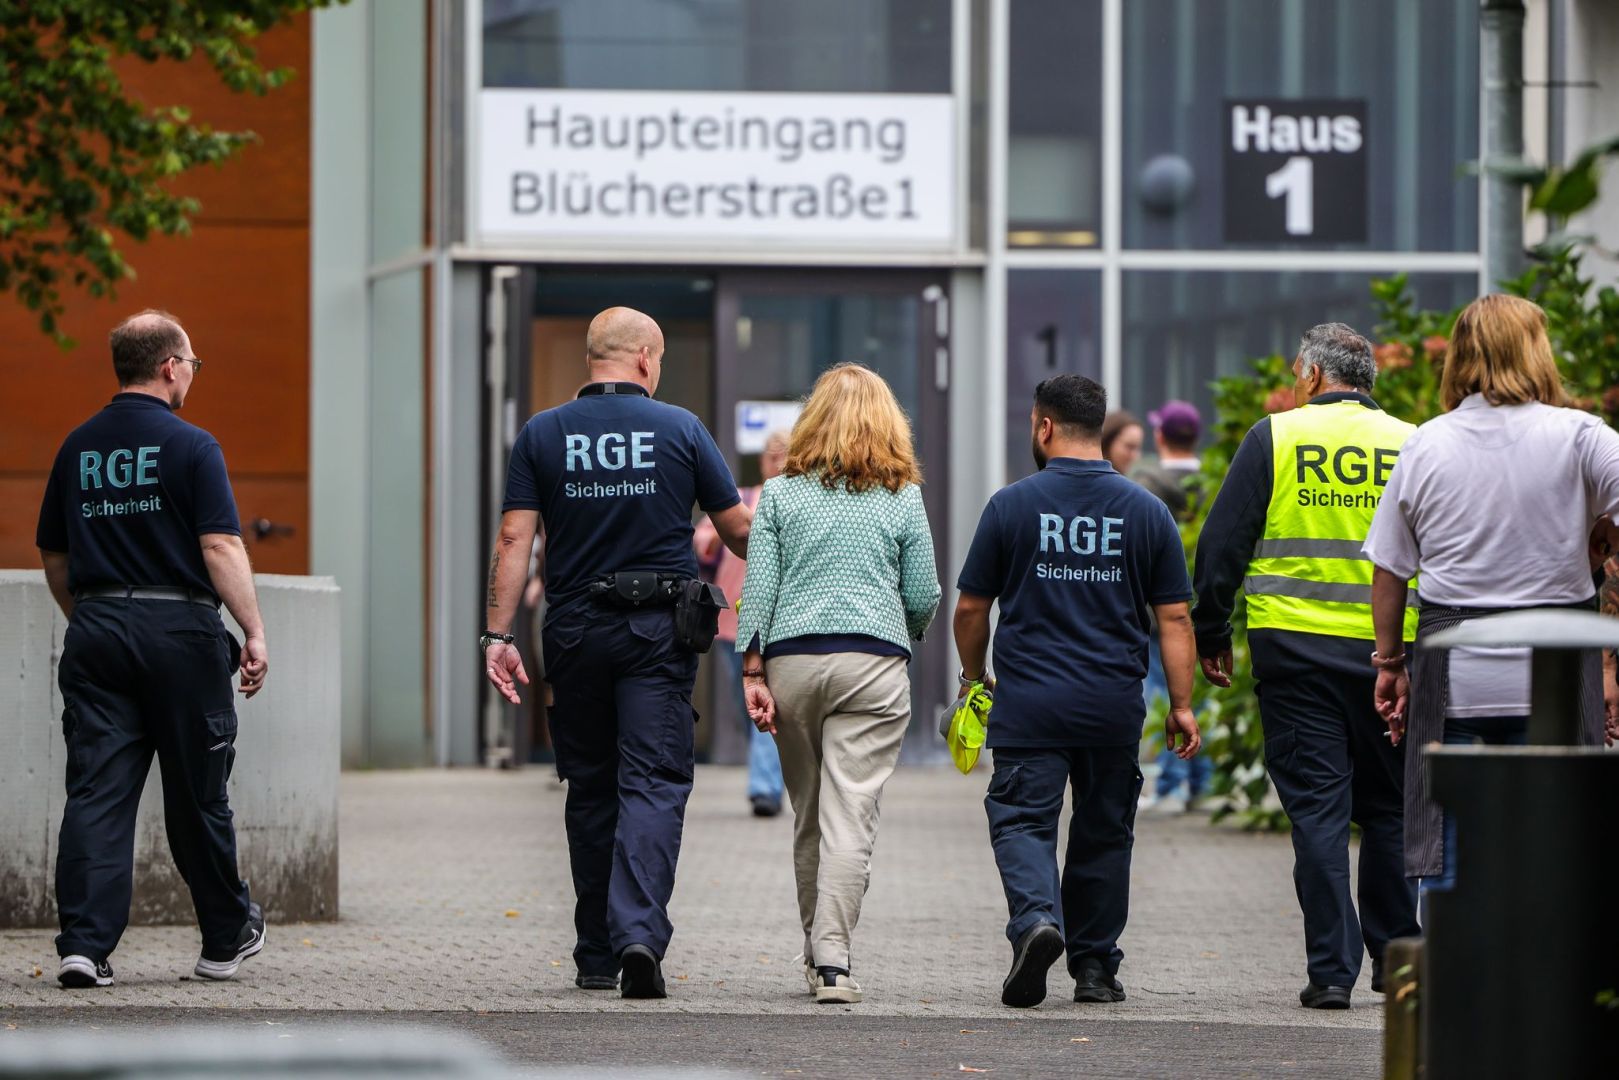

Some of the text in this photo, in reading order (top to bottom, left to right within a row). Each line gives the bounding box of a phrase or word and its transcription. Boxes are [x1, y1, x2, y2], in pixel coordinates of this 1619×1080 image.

[526, 104, 907, 163] Haupteingang
[1232, 105, 1362, 152] Haus
[1265, 156, 1313, 235] 1
[1035, 324, 1058, 369] 1
[80, 446, 160, 490] RGE
[565, 431, 656, 472] RGE
[1295, 444, 1400, 487] RGE
[82, 495, 161, 518] Sicherheit
[565, 478, 657, 498] Sicherheit
[1040, 513, 1124, 556] RGE
[1036, 563, 1122, 582] Sicherheit
